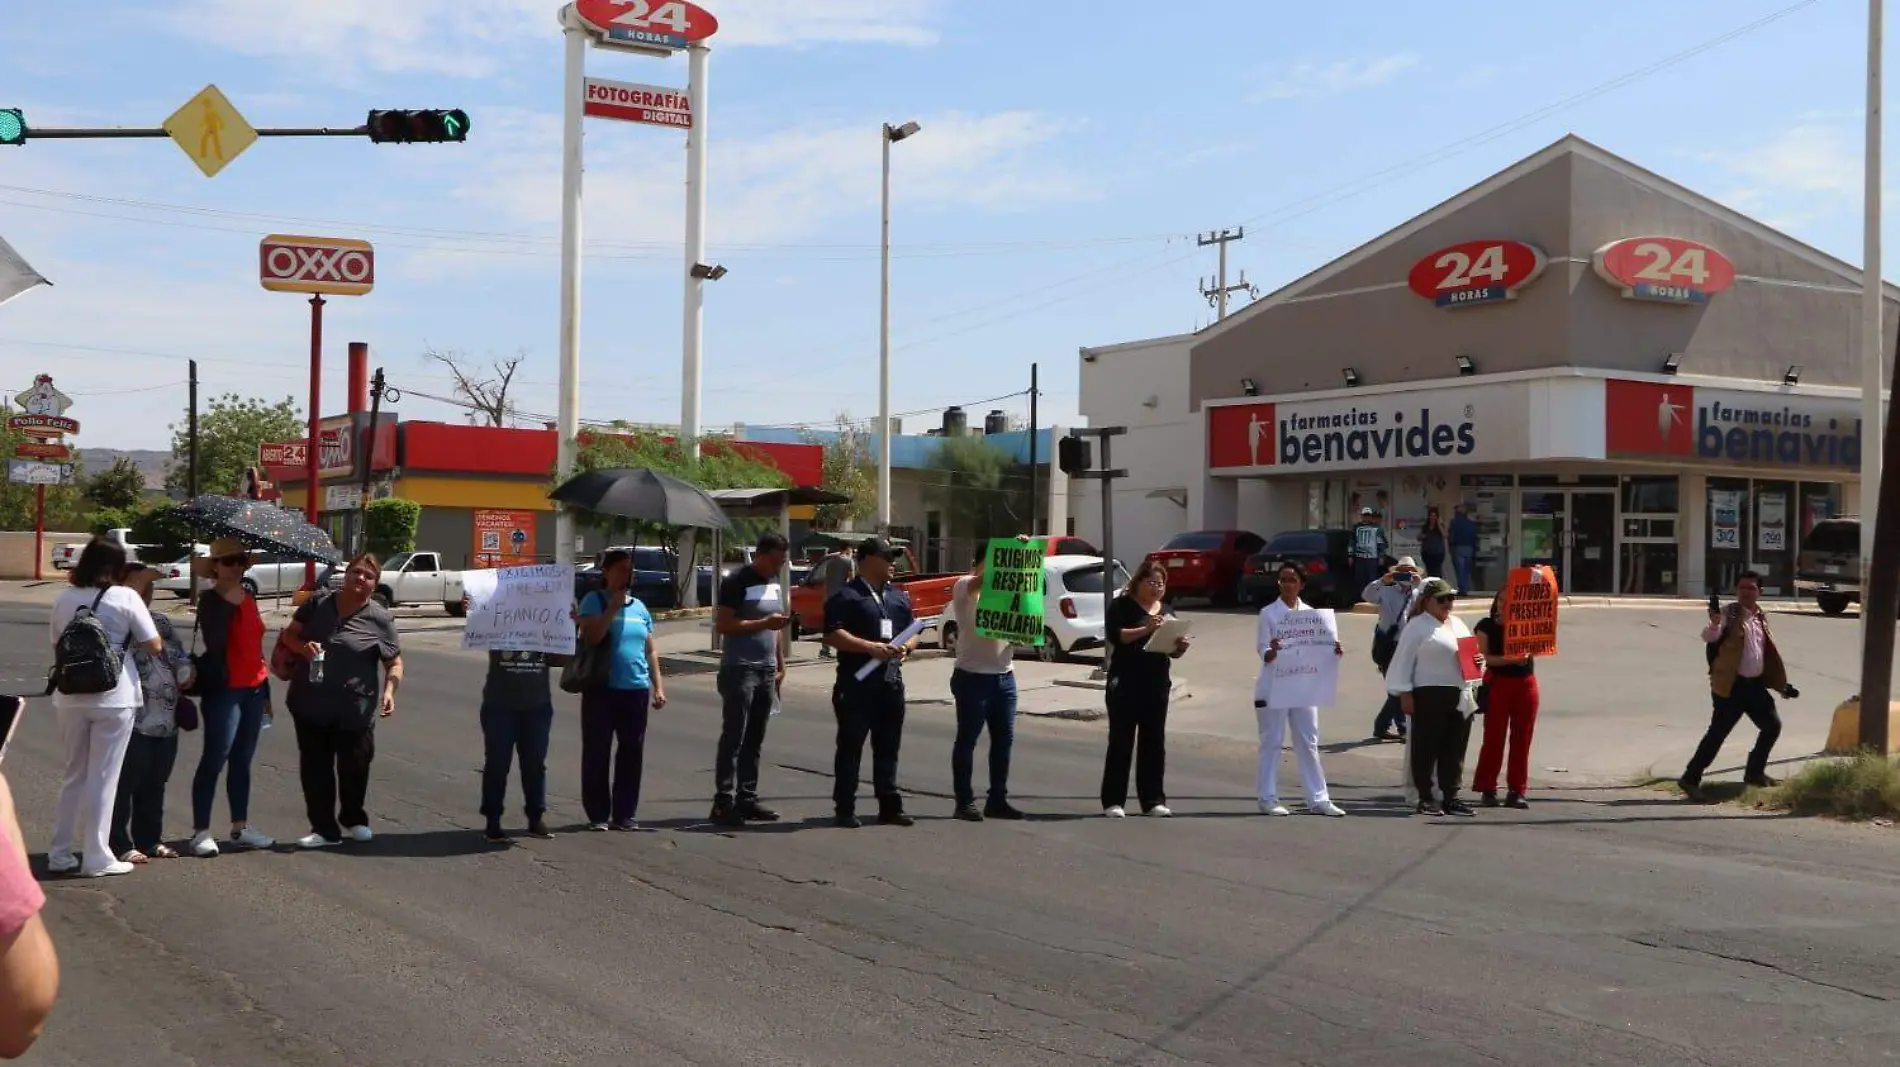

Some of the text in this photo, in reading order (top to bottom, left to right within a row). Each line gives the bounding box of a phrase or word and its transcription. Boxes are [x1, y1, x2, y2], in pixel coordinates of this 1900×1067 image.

[609, 0, 691, 33] 24
[627, 29, 669, 43] HORAS
[587, 84, 690, 111] FOTOGRAFÍA
[643, 110, 690, 125] DIGITAL
[268, 247, 370, 281] OXXO
[1435, 245, 1509, 289] 24
[1632, 242, 1710, 285] 24
[1451, 288, 1489, 302] HORAS
[1651, 286, 1690, 299] HORAS
[1290, 408, 1378, 430] farmacias
[1712, 401, 1812, 428] farmacias
[1280, 408, 1475, 465] benavides
[285, 446, 305, 460] 24
[993, 547, 1041, 568] EXIGIMOS
[991, 571, 1038, 592] RESPETO
[1010, 593, 1020, 612] A
[1510, 602, 1553, 619] PRESENTE
